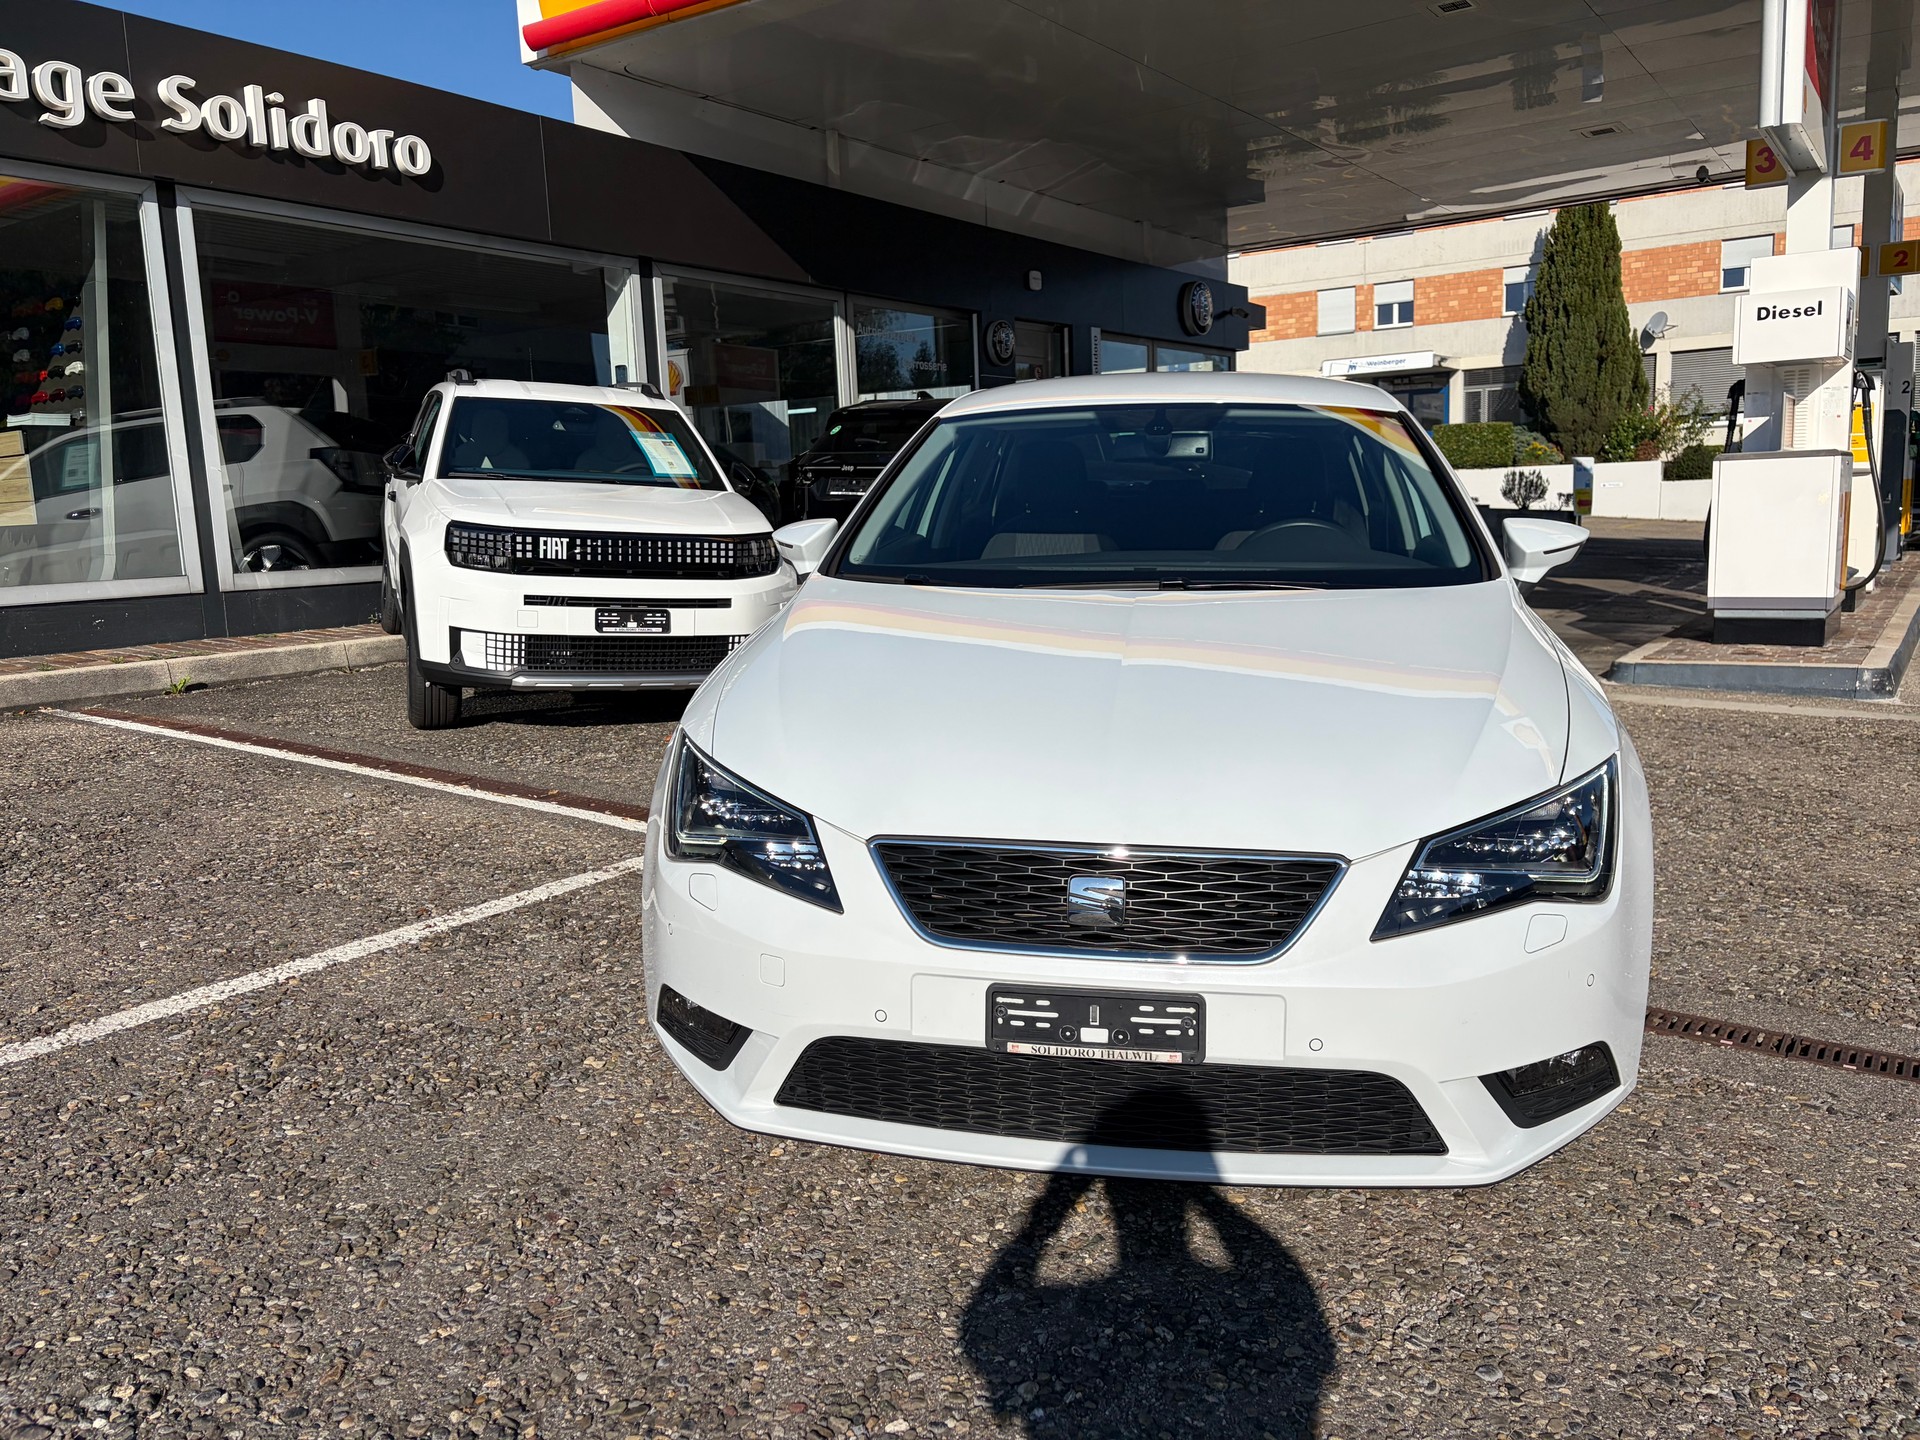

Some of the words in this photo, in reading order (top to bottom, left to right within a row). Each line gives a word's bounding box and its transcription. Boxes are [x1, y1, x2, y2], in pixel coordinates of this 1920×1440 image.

[157, 74, 432, 177] Solidoro
[1850, 135, 1874, 161] 4
[1755, 146, 1776, 173] 3
[1893, 249, 1909, 267] 2
[1757, 300, 1823, 321] Diesel
[1366, 358, 1407, 367] Weinberger
[1901, 380, 1911, 393] 2
[841, 464, 854, 472] Jeep
[539, 537, 569, 559] FIAT
[1031, 1045, 1096, 1058] SOLIDORO
